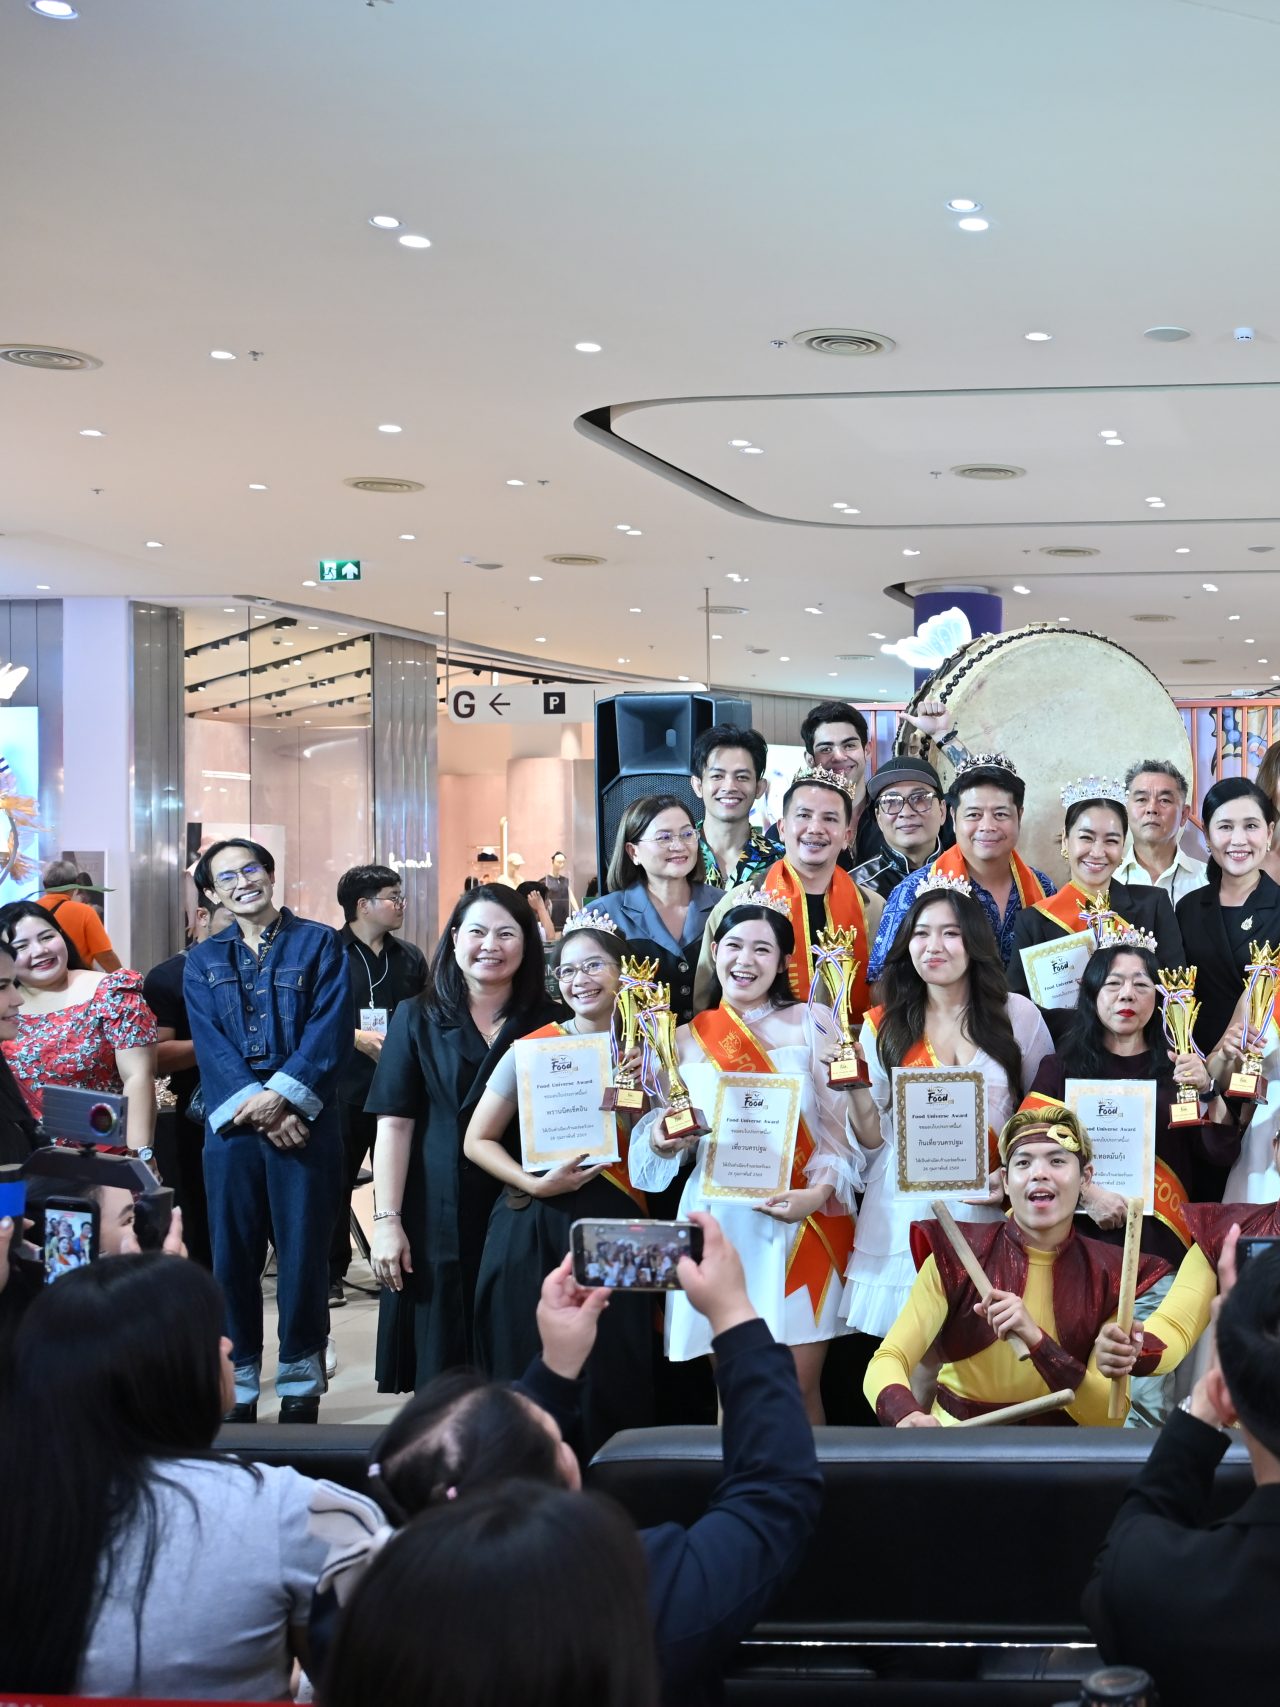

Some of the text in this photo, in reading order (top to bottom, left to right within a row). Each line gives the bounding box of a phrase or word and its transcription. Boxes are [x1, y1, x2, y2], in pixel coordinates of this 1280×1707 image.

[453, 691, 560, 718] G P
[1052, 961, 1069, 973] Food
[551, 1061, 572, 1071] Food
[744, 1096, 764, 1107] Food
[928, 1092, 949, 1103] Food
[1098, 1105, 1119, 1115] Food
